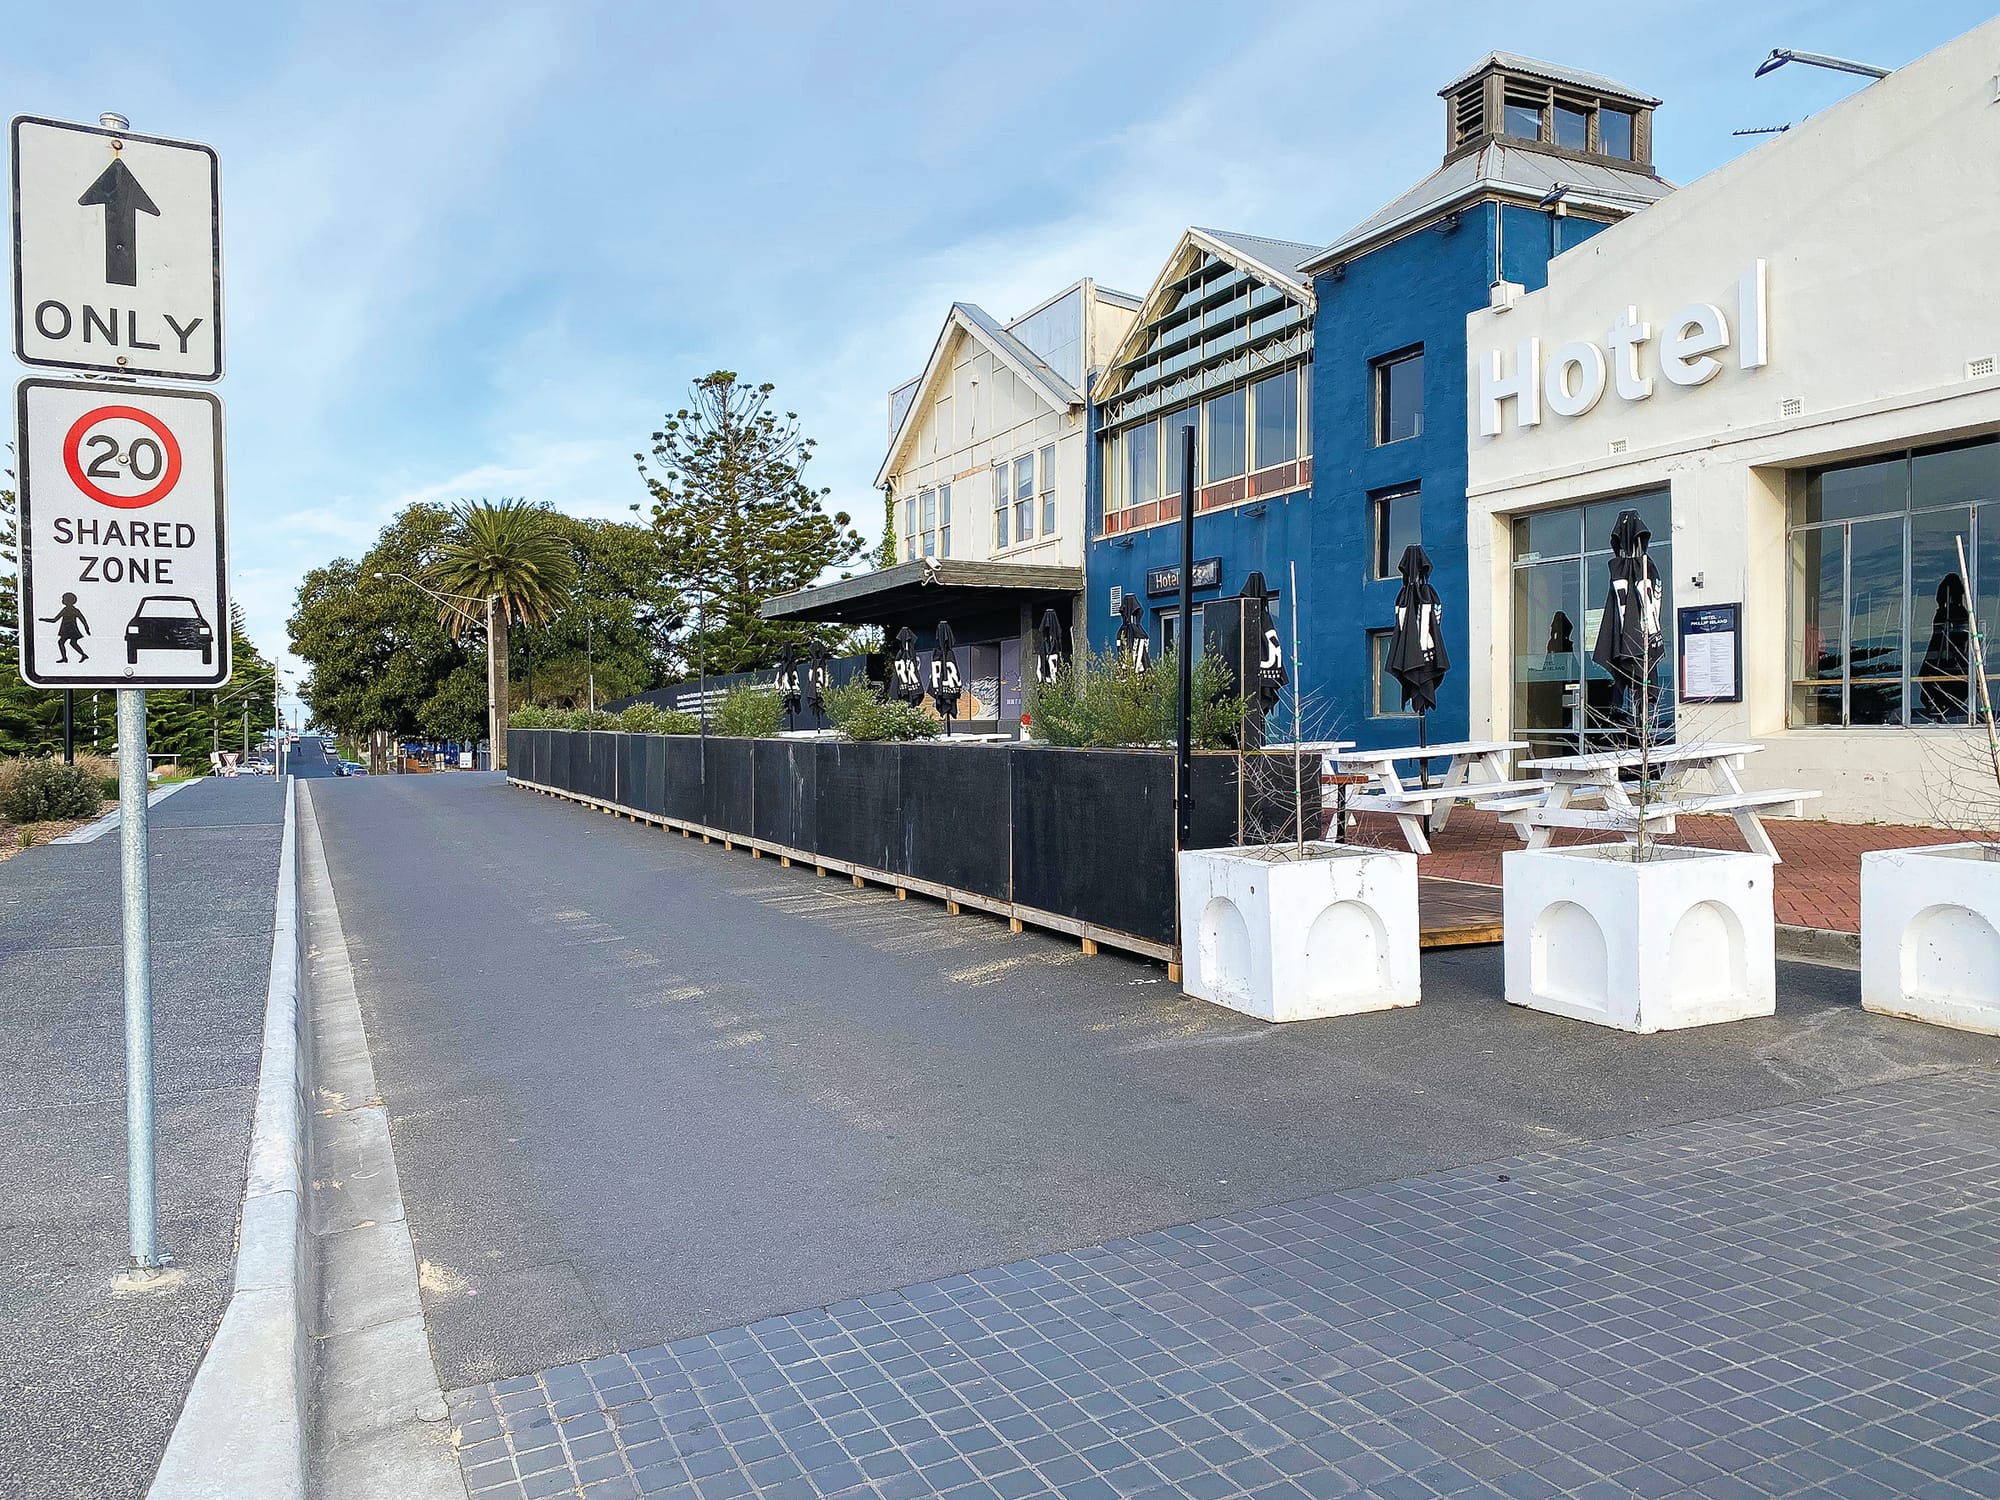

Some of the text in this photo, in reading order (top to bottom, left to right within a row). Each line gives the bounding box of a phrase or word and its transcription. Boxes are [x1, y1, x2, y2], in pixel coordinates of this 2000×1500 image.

[35, 300, 204, 354] ONLY
[1479, 257, 1768, 437] Hotel
[86, 434, 163, 481] 20
[53, 517, 196, 549] SHARED
[78, 555, 174, 585] ZONE
[1156, 569, 1180, 589] Hotel
